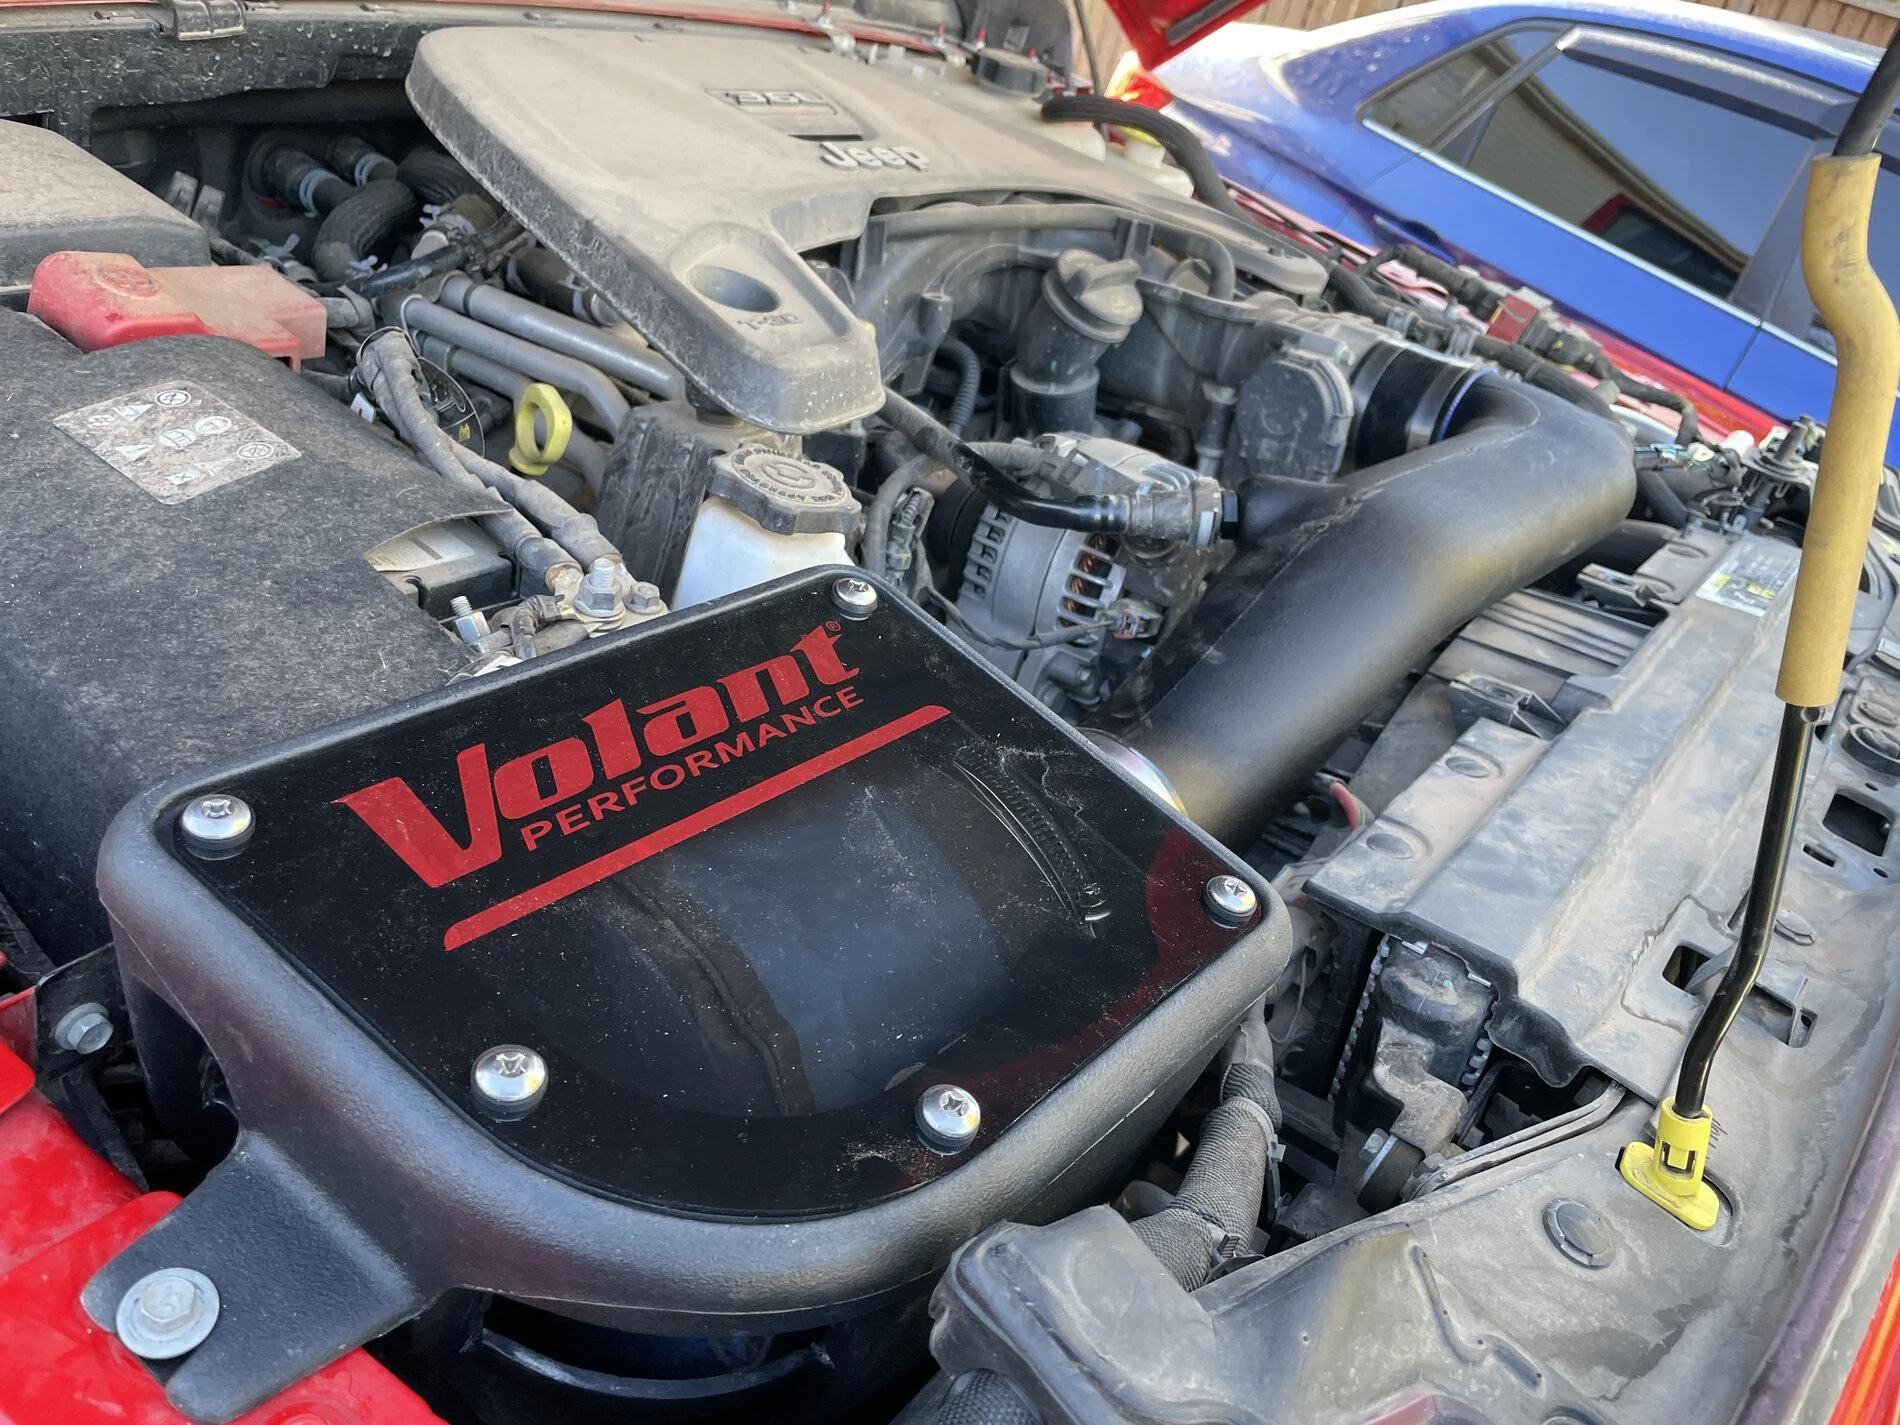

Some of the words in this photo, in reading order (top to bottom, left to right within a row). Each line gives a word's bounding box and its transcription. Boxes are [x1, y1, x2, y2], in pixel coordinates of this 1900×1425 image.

[820, 142, 931, 171] Jeep
[332, 624, 860, 888] Volant
[520, 686, 863, 851] PERFORMANCE
